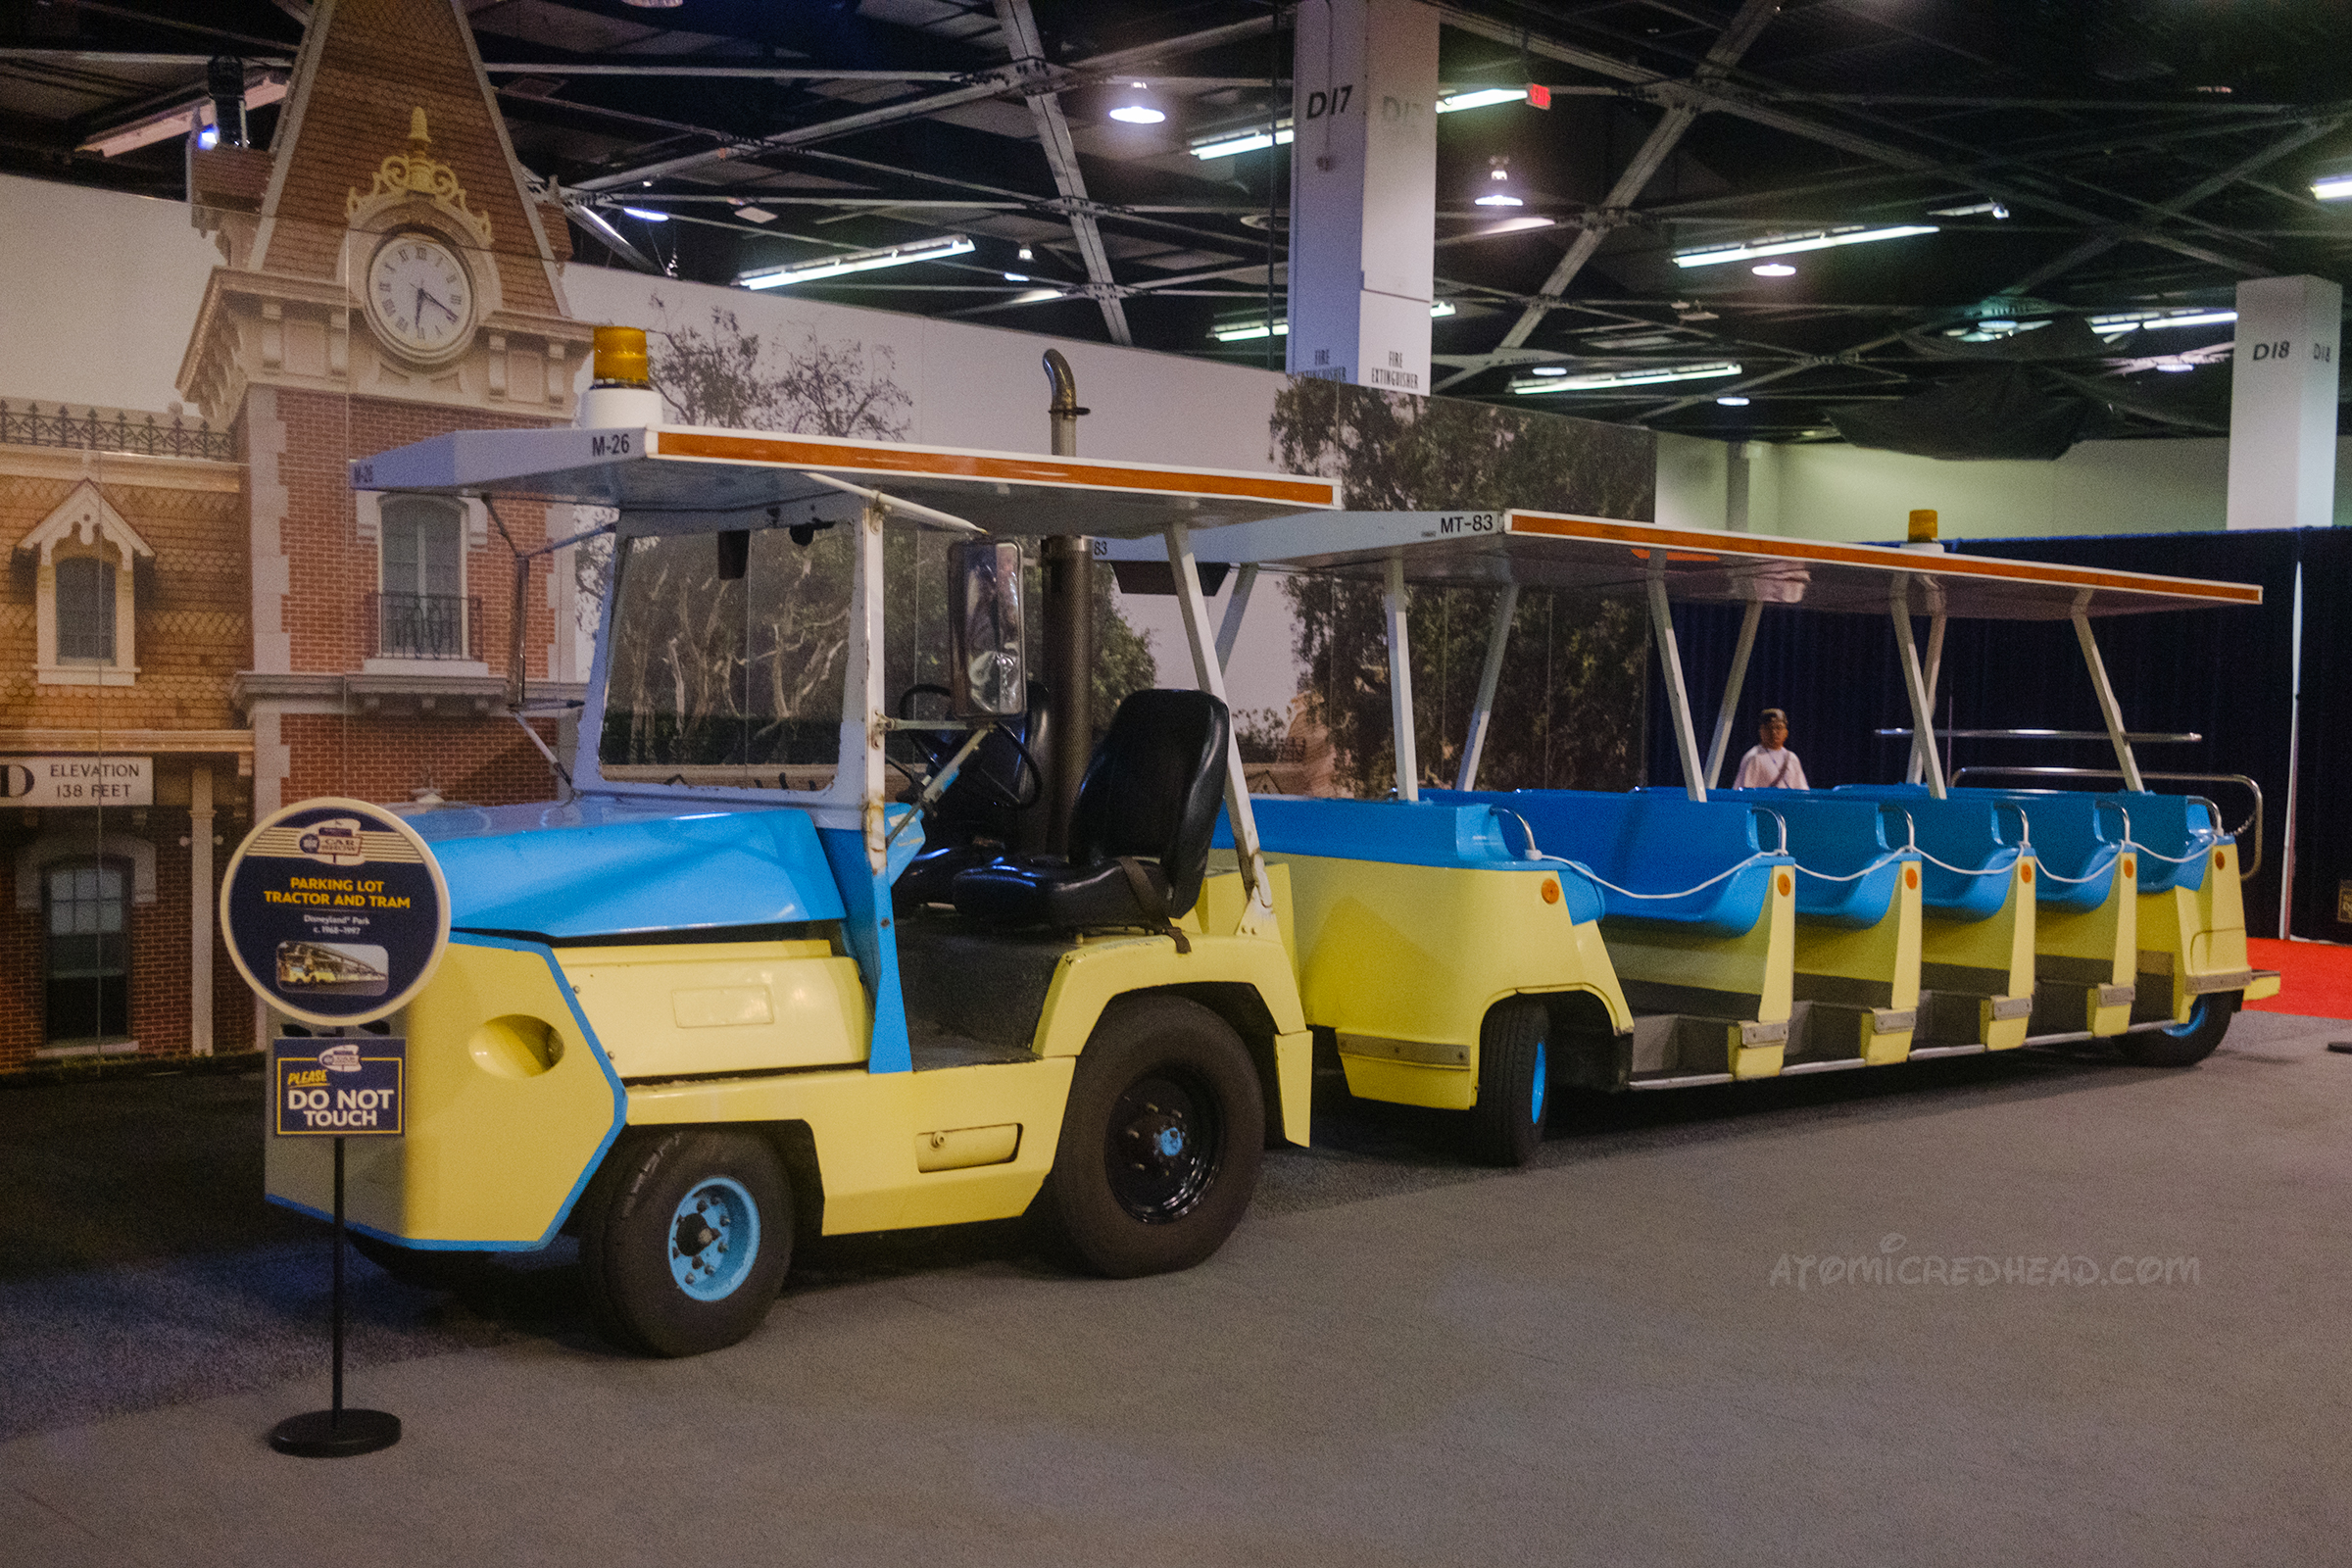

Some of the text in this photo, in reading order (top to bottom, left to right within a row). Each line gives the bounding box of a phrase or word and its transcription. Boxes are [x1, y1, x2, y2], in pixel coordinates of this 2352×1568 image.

[1306, 84, 1353, 120] D17
[2253, 339, 2290, 361] D18
[1389, 351, 1402, 368] FIRE
[1372, 367, 1418, 389] EXTINGUISHER
[592, 433, 630, 457] M-26
[1441, 514, 1494, 533] MT-83
[50, 763, 139, 777] ELEVATION
[57, 784, 131, 798] 138 FEET
[290, 877, 384, 893] PARKING LOT
[264, 891, 411, 908] TRACTOR AND TRAM
[287, 1069, 328, 1086] PLEASE
[288, 1089, 394, 1109] DO NOT
[303, 1110, 377, 1127] TOUCH
